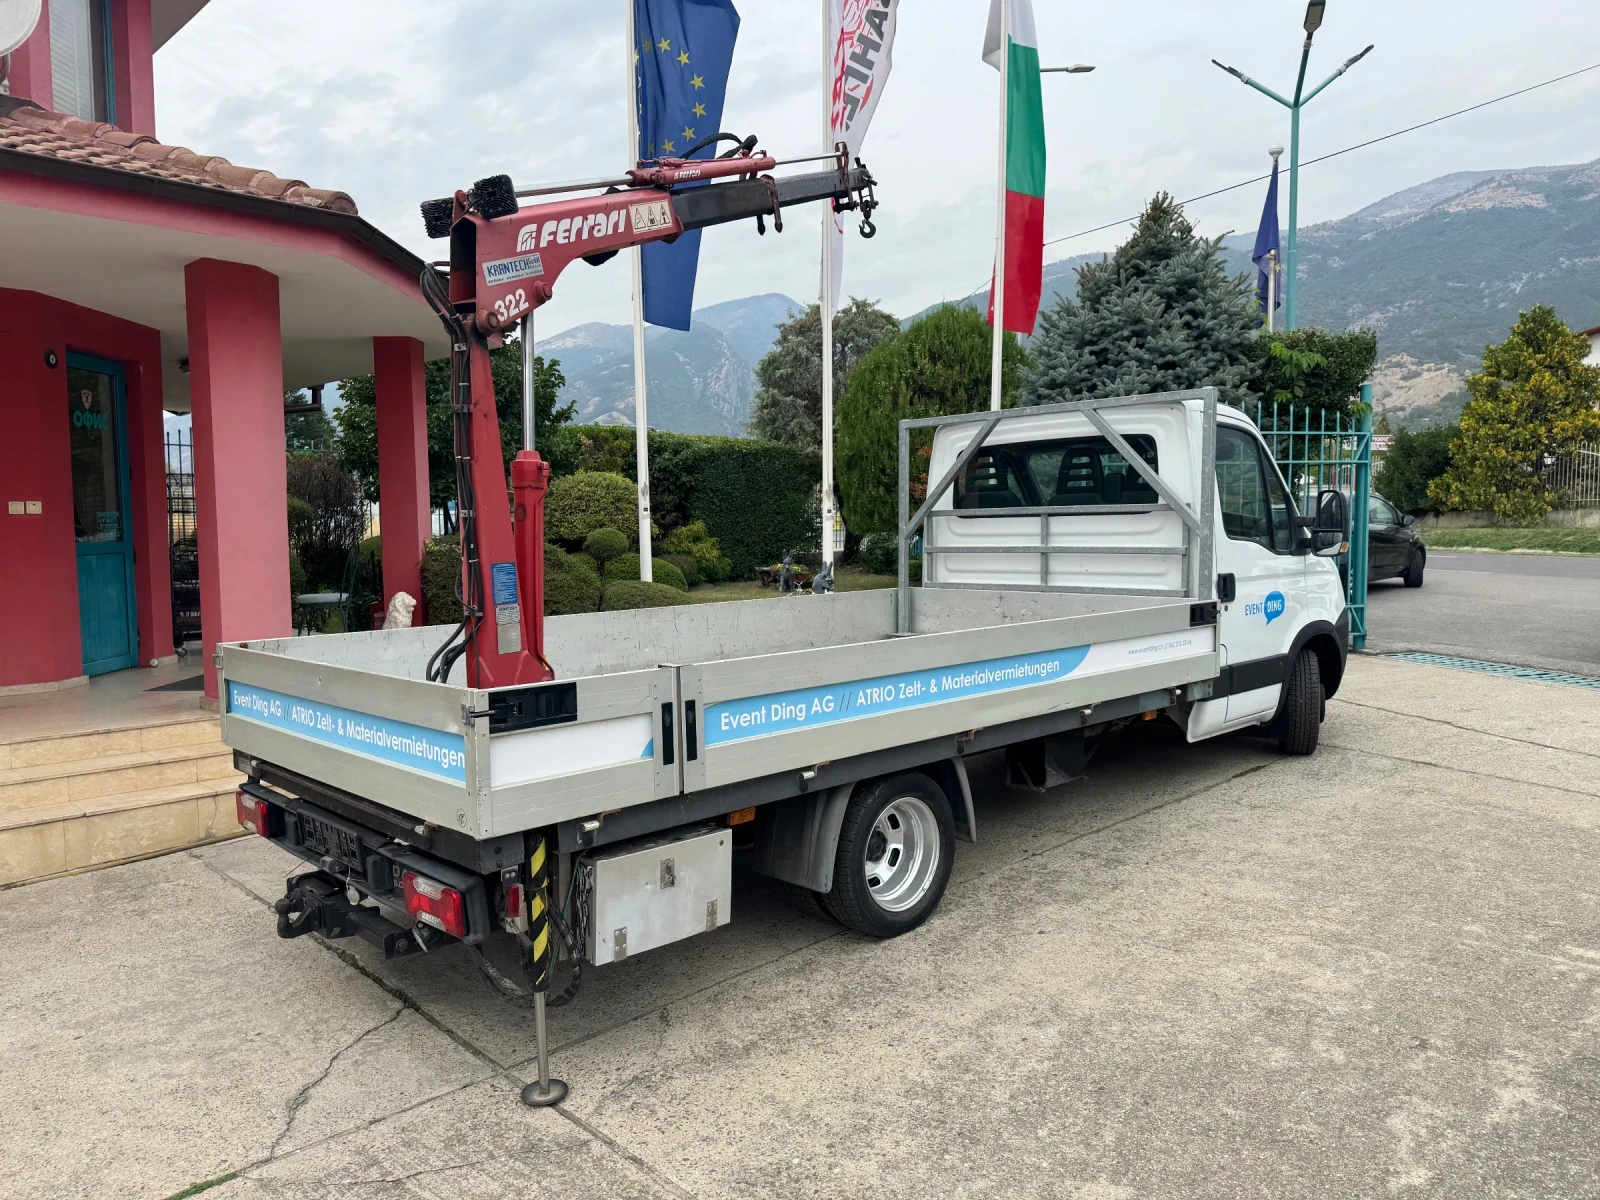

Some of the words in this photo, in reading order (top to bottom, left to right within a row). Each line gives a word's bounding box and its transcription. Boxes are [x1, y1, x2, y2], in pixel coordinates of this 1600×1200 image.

[486, 257, 531, 278] KRANTECH
[494, 288, 529, 321] 322
[73, 409, 109, 430] ОФИС
[1244, 602, 1264, 616] EVENT
[1267, 599, 1282, 613] DING
[720, 705, 767, 731] Event
[771, 701, 806, 722] Ding
[811, 695, 835, 715] AG
[856, 684, 896, 707] ATRIO
[898, 680, 926, 700] Zelt-
[929, 678, 938, 694] &
[941, 660, 1060, 692] Materialvermietungen
[233, 690, 252, 709] Event
[252, 694, 269, 717] Ding
[269, 699, 282, 717] AG
[291, 705, 315, 727] ATRIO
[316, 711, 335, 732] Zelt-
[337, 718, 345, 736] &
[346, 719, 466, 769] Materialvermietungen
